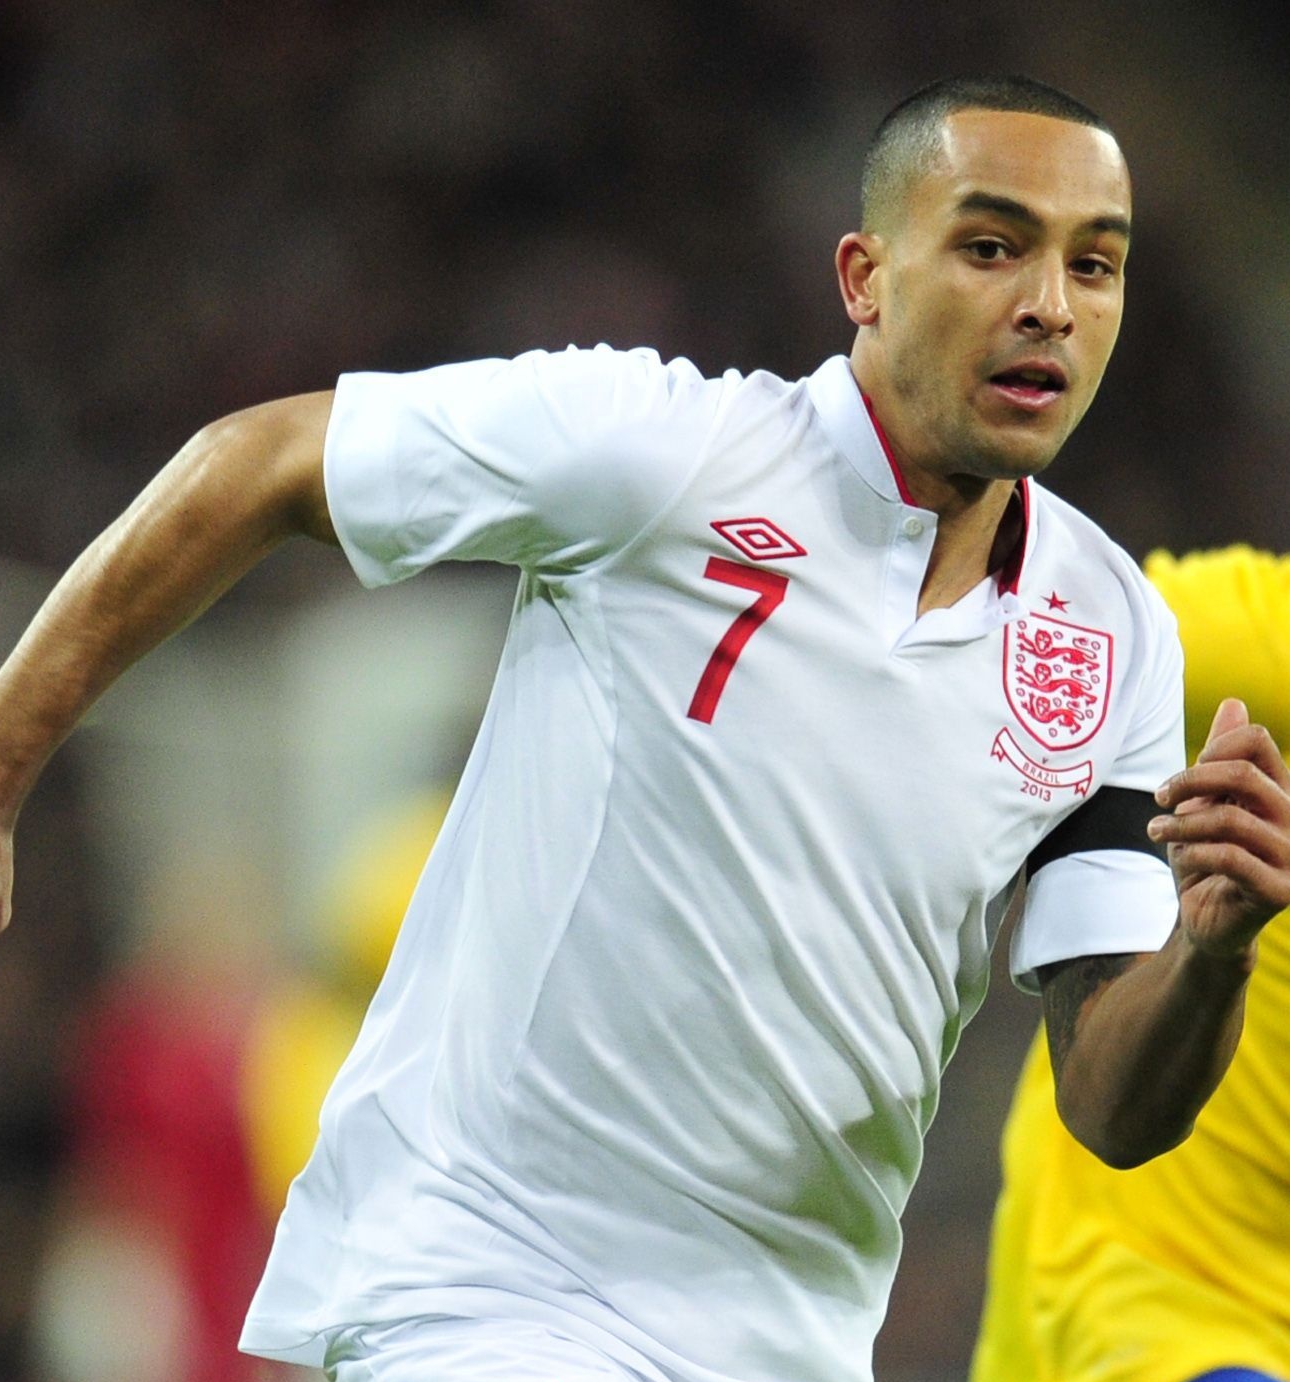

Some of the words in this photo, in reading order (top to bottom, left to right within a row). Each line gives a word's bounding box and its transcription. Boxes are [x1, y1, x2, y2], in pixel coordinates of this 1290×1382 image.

[686, 556, 790, 725] 7
[1022, 762, 1060, 784] BRAZIL
[1020, 780, 1052, 802] 2013
